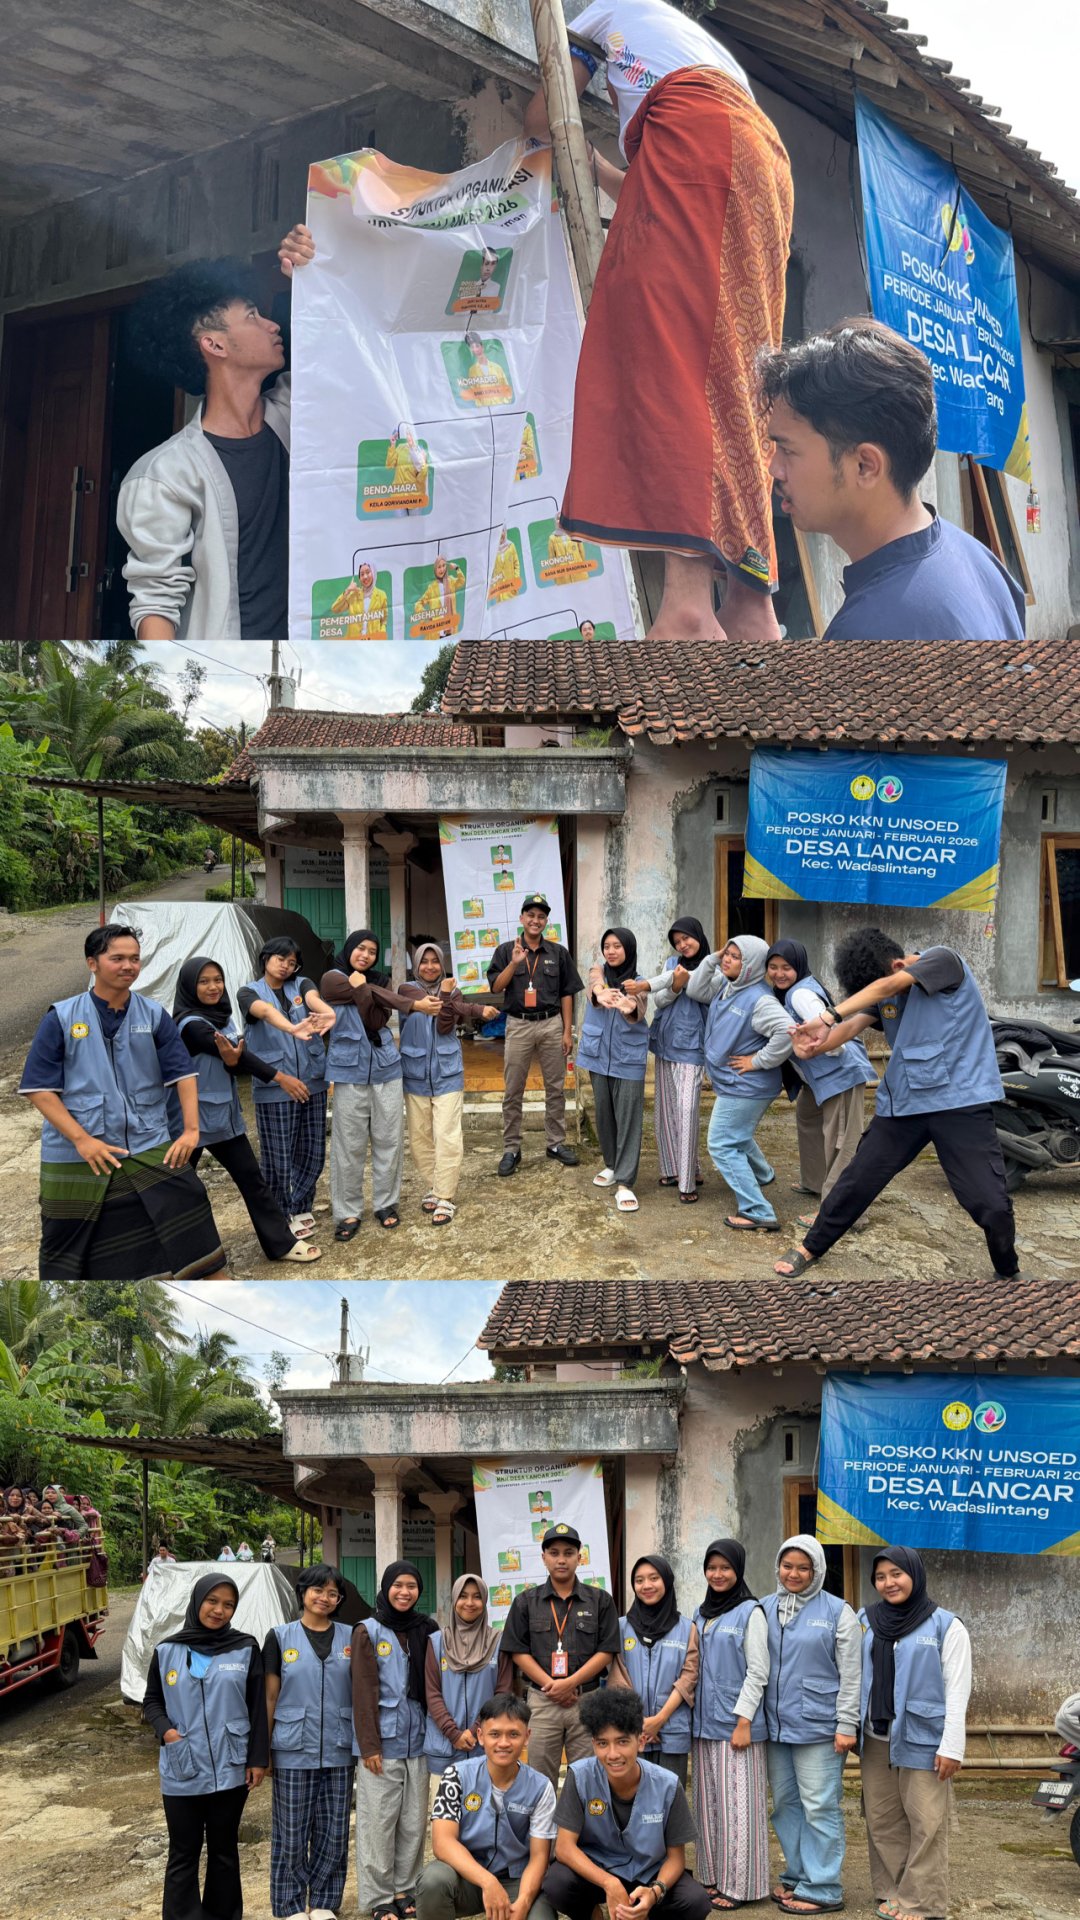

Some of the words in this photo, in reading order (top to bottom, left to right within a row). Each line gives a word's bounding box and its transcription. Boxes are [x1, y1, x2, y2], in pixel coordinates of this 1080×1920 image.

[901, 250, 947, 292] POSKO
[883, 274, 932, 310] PERIODE
[933, 298, 978, 329] JANUAR
[907, 309, 959, 360] DESA
[363, 483, 417, 496] BENDAHARA
[540, 553, 573, 567] EKONOMI
[320, 610, 385, 627] PEMERINTAHAN
[410, 607, 448, 622] KESEHATAN
[320, 628, 343, 638] DESA
[787, 811, 845, 826] POSKO
[849, 814, 883, 828] KKN
[888, 818, 959, 833] UNSOED
[766, 825, 819, 836] PERIODE
[822, 828, 875, 840] JANUARI
[884, 832, 946, 845] FEBRUARI
[948, 836, 978, 847] 2026
[785, 839, 850, 857] DESA
[857, 842, 957, 864] LANCAR
[801, 858, 834, 870] Kec.
[837, 860, 936, 878] Wadaslintang
[868, 1444, 936, 1459] POSKO
[942, 1447, 982, 1461] KKN
[988, 1450, 1077, 1466] UNSOED
[495, 1466, 533, 1475] STRUKTUR
[844, 1461, 907, 1473] PERIODE
[910, 1463, 973, 1475] JANUARI
[984, 1466, 1060, 1480] FEBRUARI
[1063, 1470, 1080, 1480] 20
[868, 1475, 944, 1496] DESA
[952, 1480, 1074, 1503] LANCAR
[887, 1497, 924, 1511] Kec.
[929, 1500, 1049, 1519] Wadaslintang
